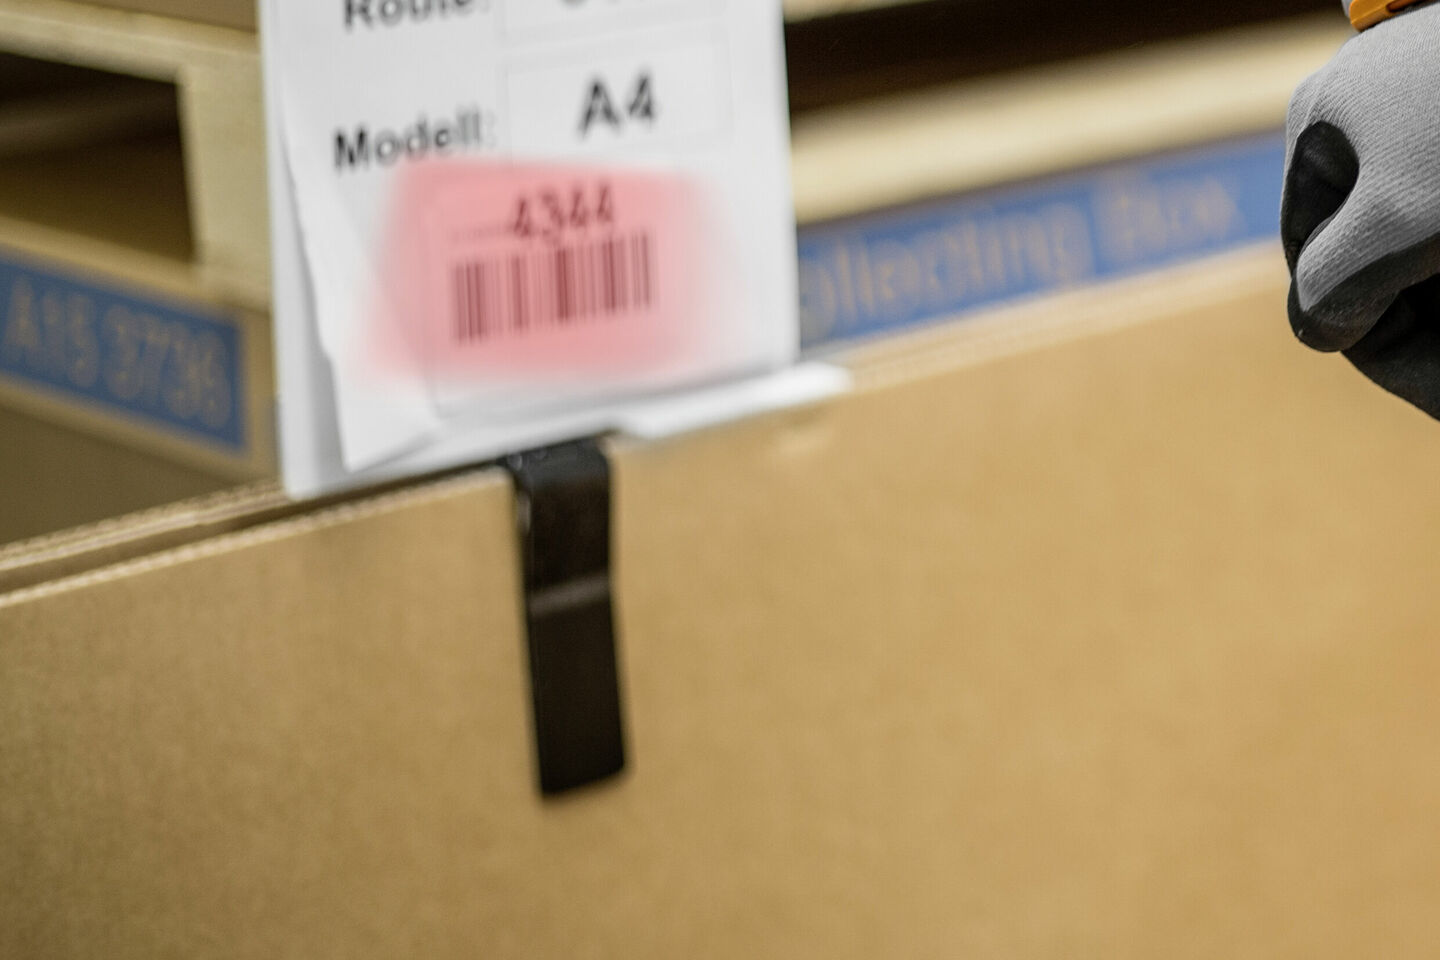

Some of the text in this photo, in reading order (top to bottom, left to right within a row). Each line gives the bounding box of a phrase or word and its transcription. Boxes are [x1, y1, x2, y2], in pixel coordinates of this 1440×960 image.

[334, 69, 659, 171] Modell: A4
[510, 180, 616, 244] 4344
